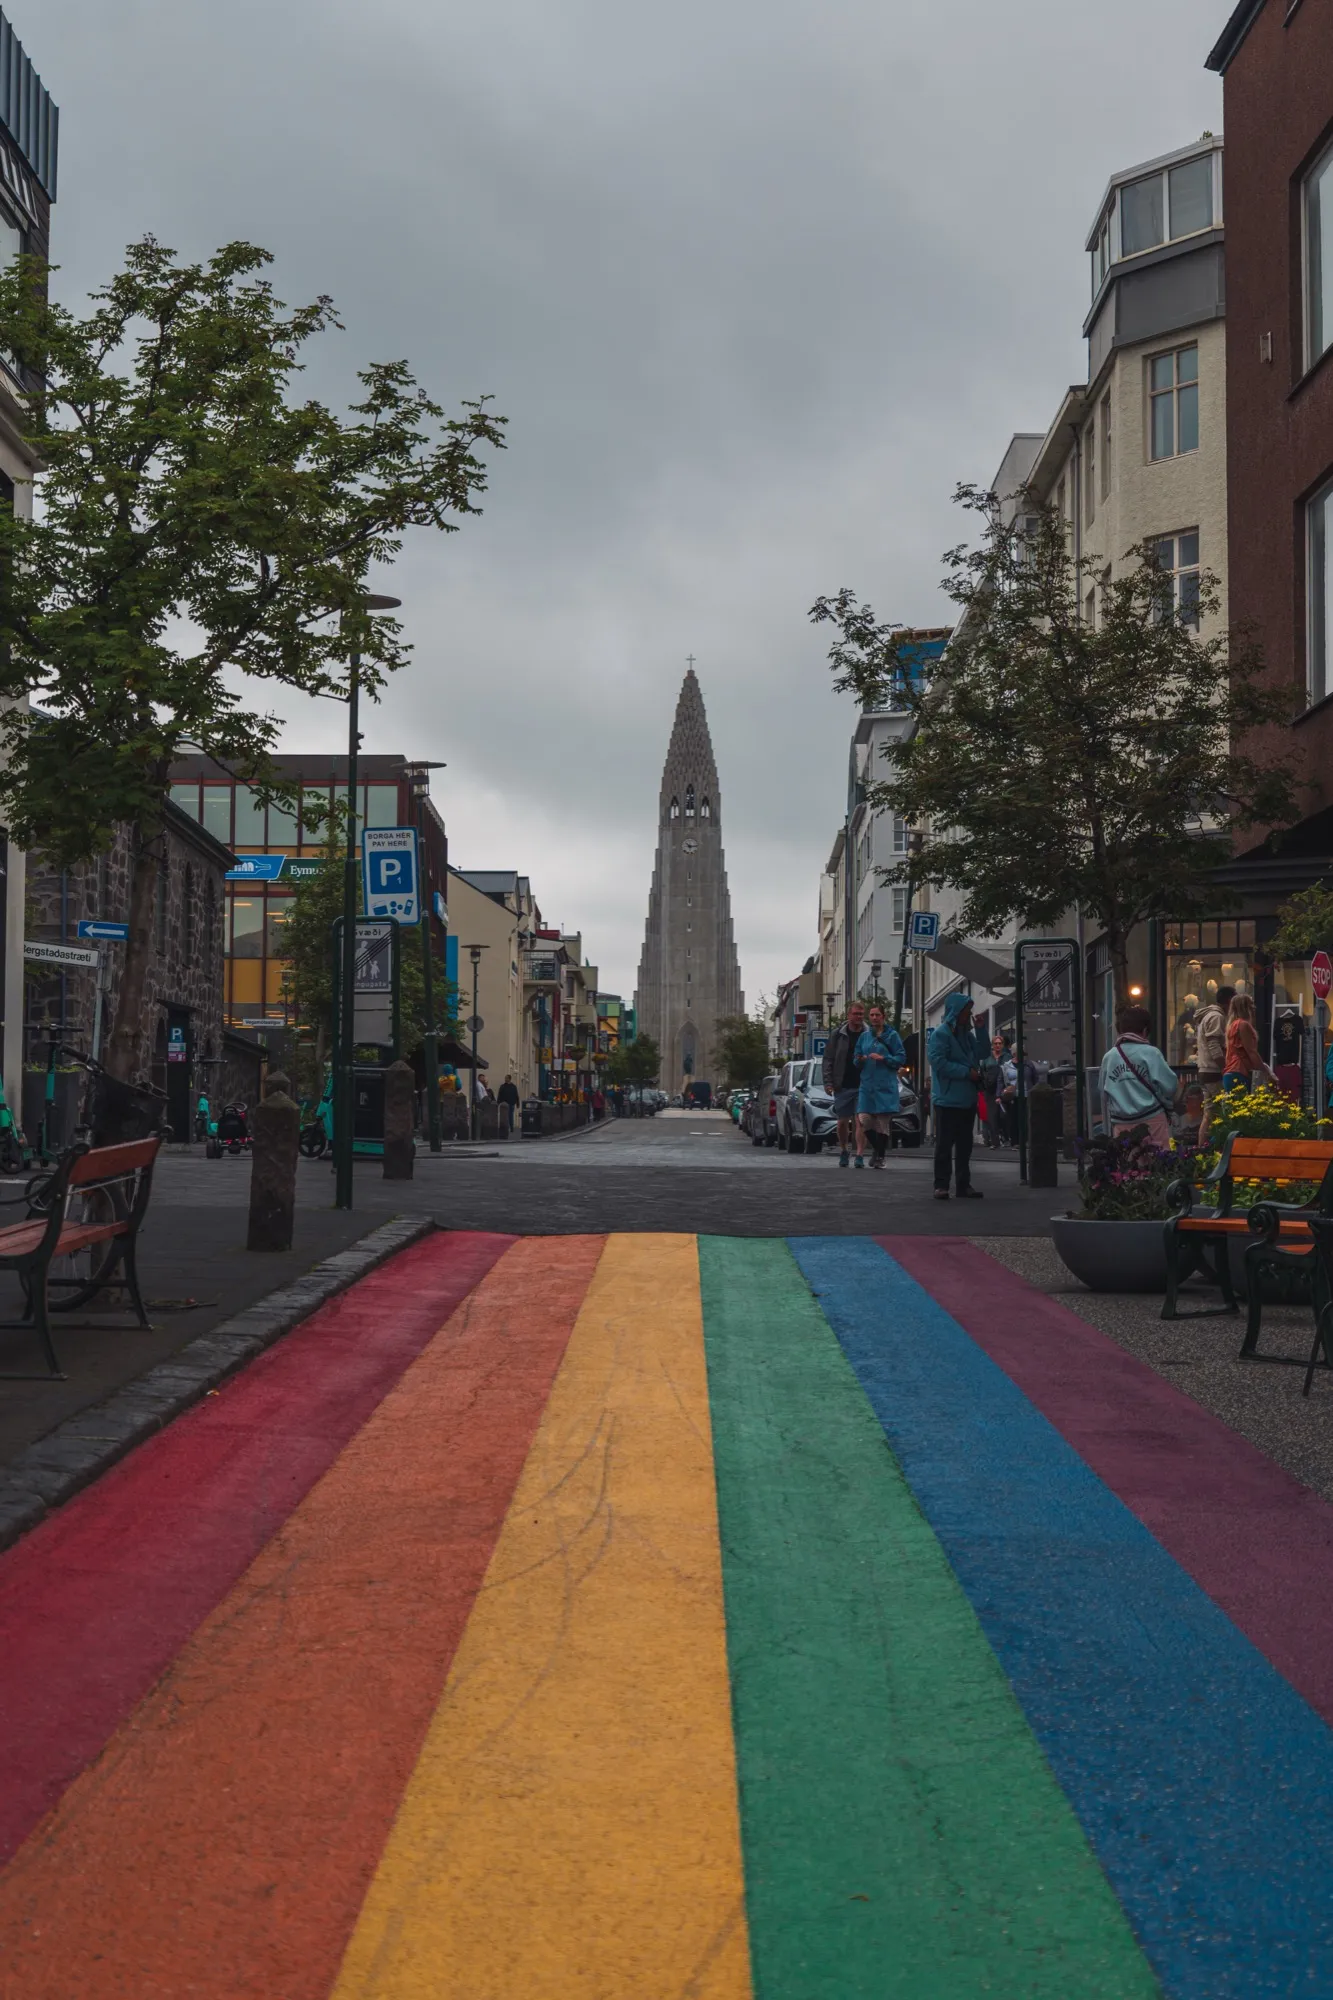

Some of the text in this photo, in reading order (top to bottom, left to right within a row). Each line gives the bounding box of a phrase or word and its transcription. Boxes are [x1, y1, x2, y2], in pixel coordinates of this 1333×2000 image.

[380, 858, 401, 887] P
[918, 917, 931, 933] P
[1312, 966, 1331, 985] STOP
[172, 1027, 182, 1040] P
[817, 1041, 826, 1053] P
